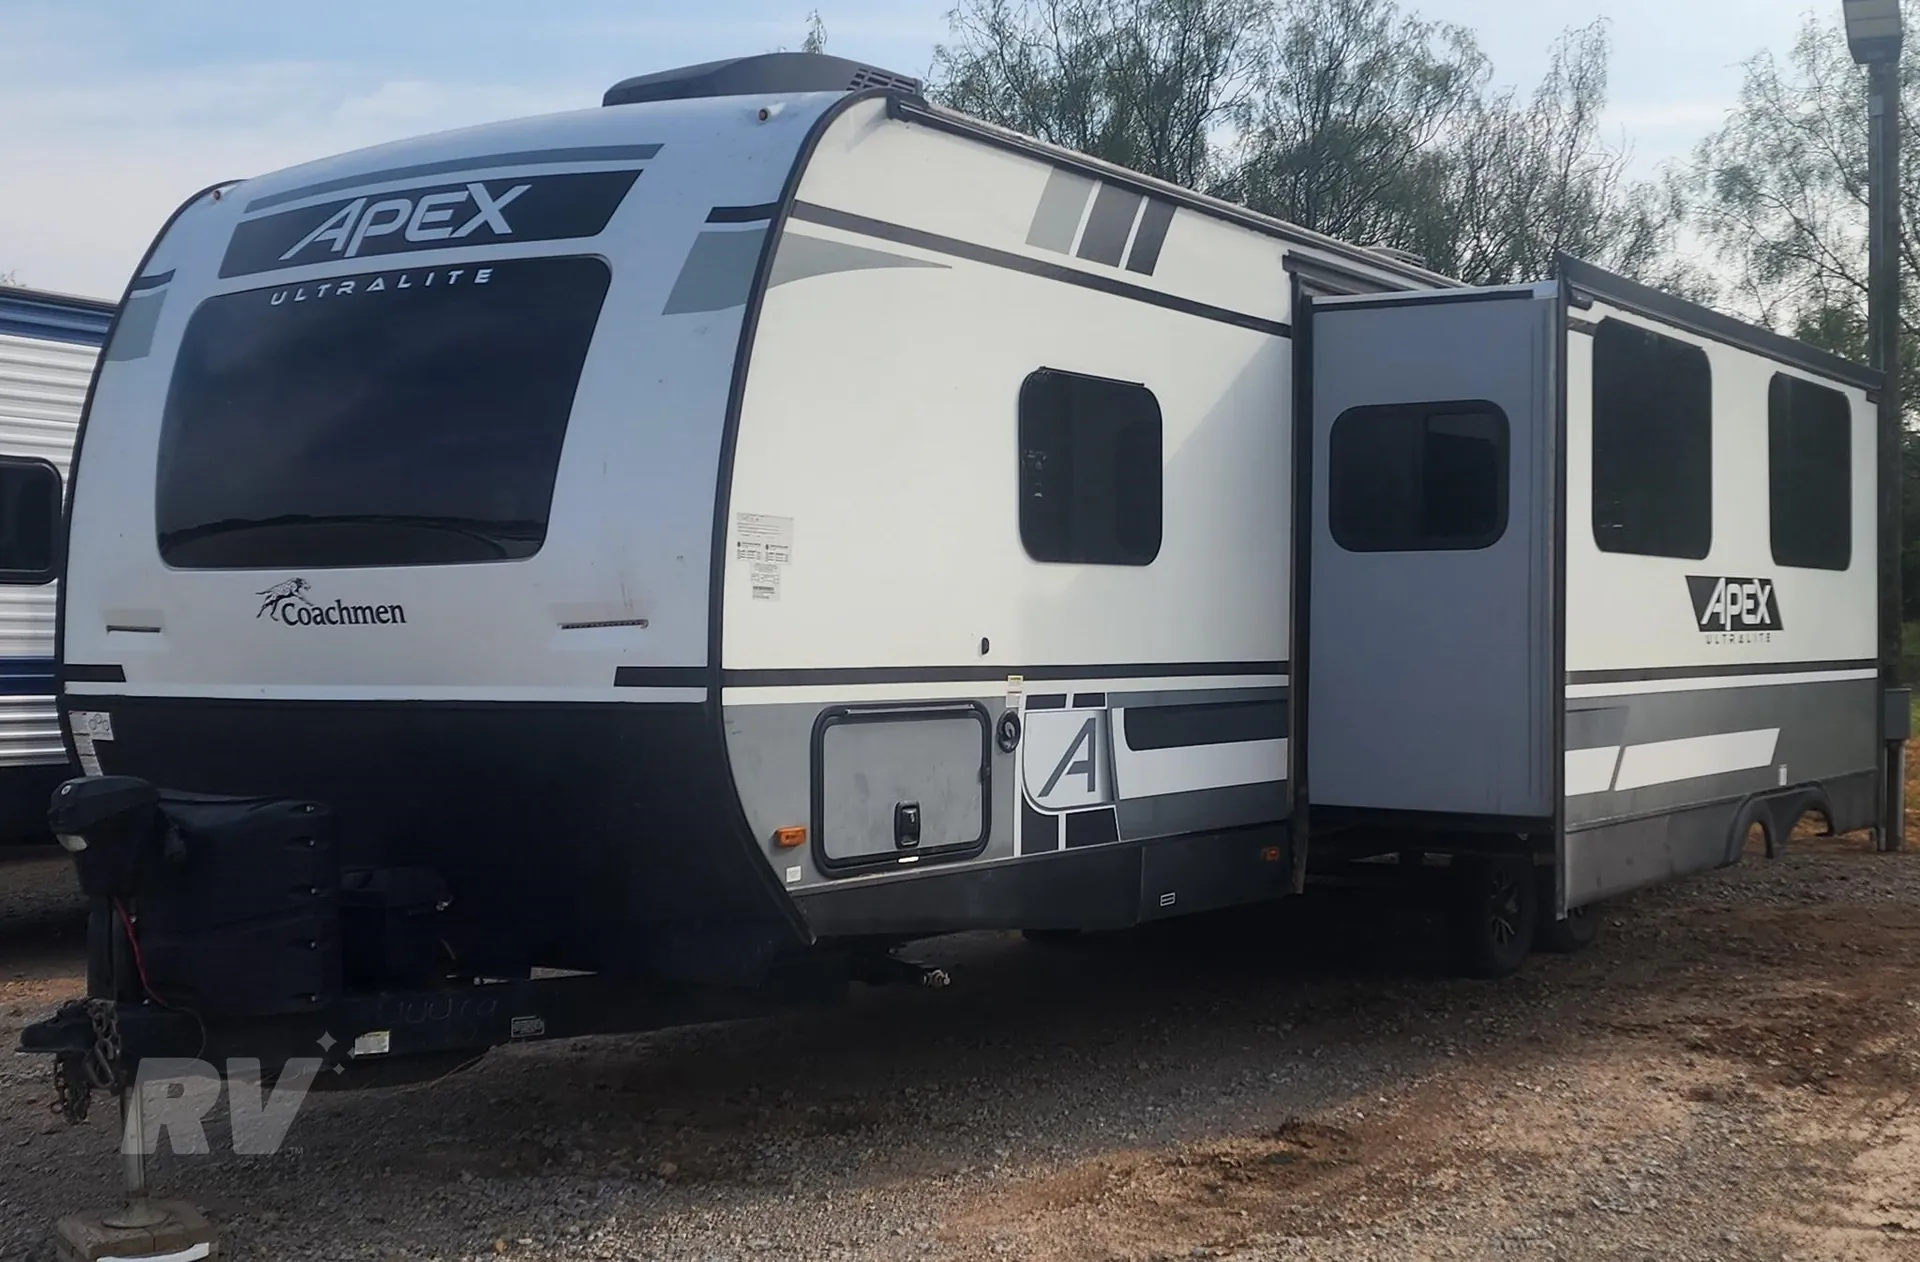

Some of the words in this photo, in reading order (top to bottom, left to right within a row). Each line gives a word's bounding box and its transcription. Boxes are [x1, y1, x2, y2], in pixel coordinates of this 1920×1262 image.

[279, 183, 532, 260] APEX
[271, 268, 494, 305] ULTRALITE
[281, 600, 406, 626] Coachmen
[1701, 577, 1771, 631] APEX
[1706, 632, 1771, 644] ULTRALITE
[1038, 717, 1096, 797] A
